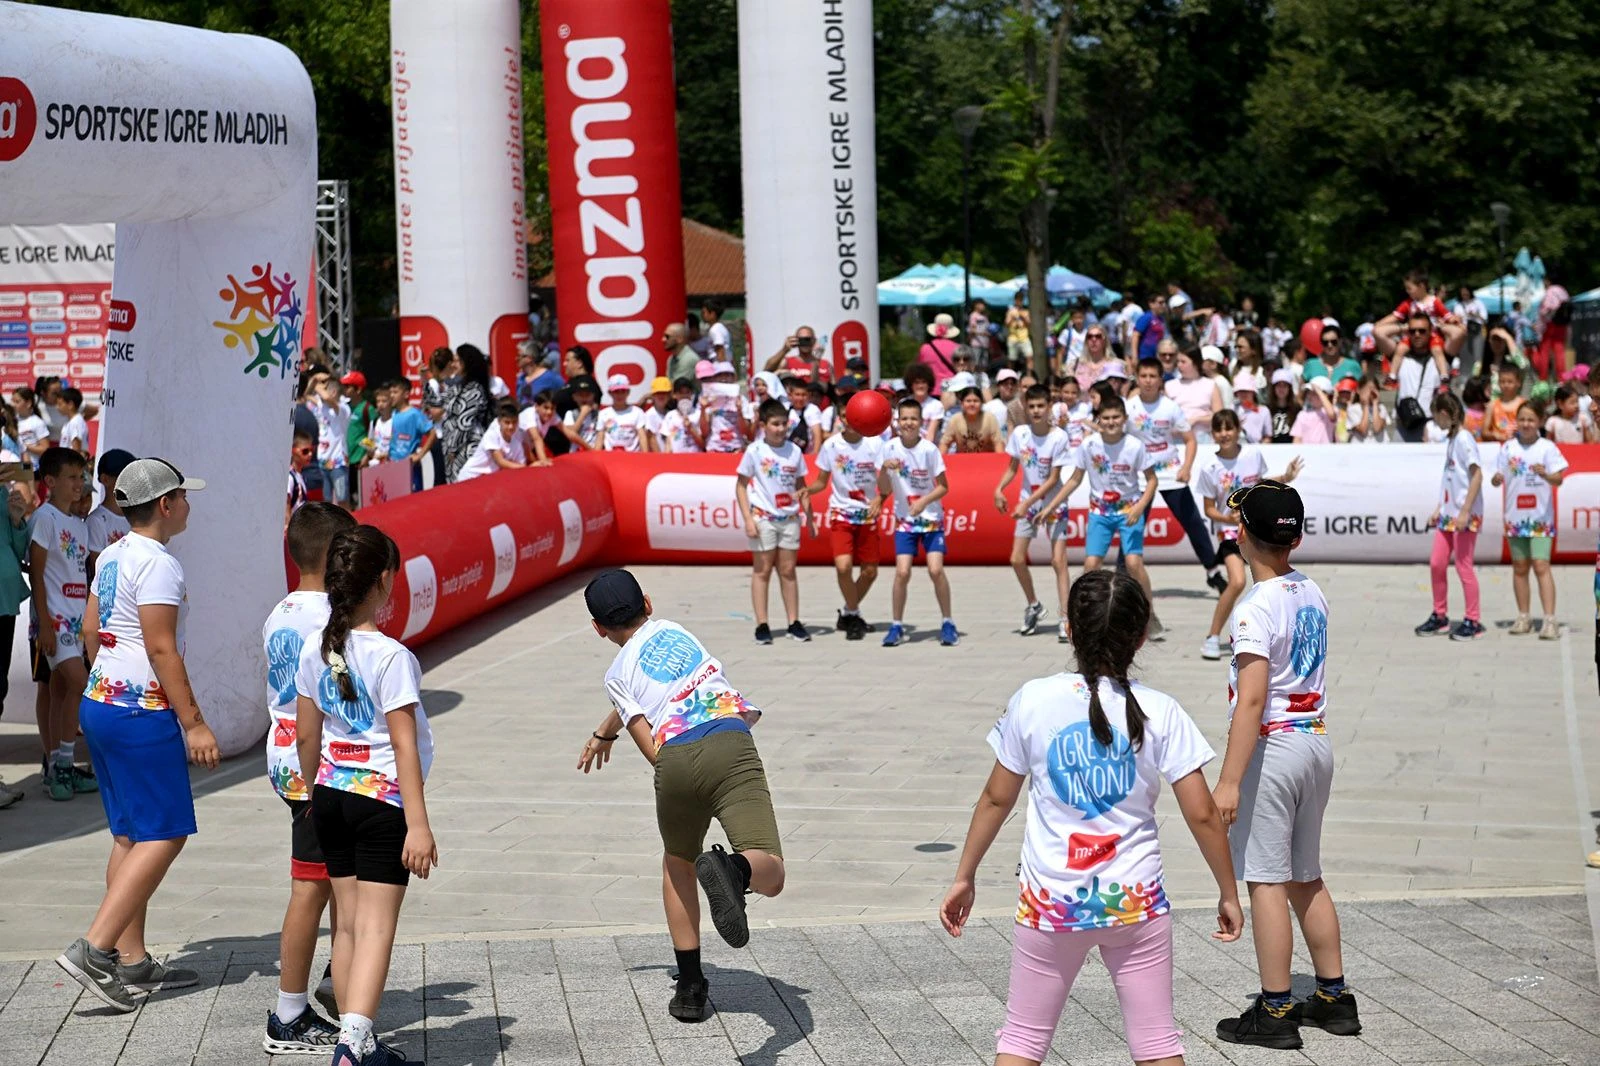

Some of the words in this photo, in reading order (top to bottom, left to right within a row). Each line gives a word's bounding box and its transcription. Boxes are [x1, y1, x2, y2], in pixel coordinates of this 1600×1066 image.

[823, 0, 848, 102] MLADIH
[45, 103, 159, 142] SPORTSKE
[164, 108, 208, 143] IGRE
[214, 110, 287, 145] MLADIH
[394, 49, 414, 194] prijatelje!
[829, 111, 852, 170] IGRE
[16, 245, 59, 265] IGRE
[65, 243, 115, 263] MLAD
[401, 203, 414, 283] imate
[510, 201, 525, 281] imate
[833, 177, 860, 311] SPORTSKE
[107, 341, 135, 361] TSKE
[659, 499, 740, 529] m:tel
[1325, 515, 1378, 535] IGRE
[1055, 726, 1097, 771] IGRE
